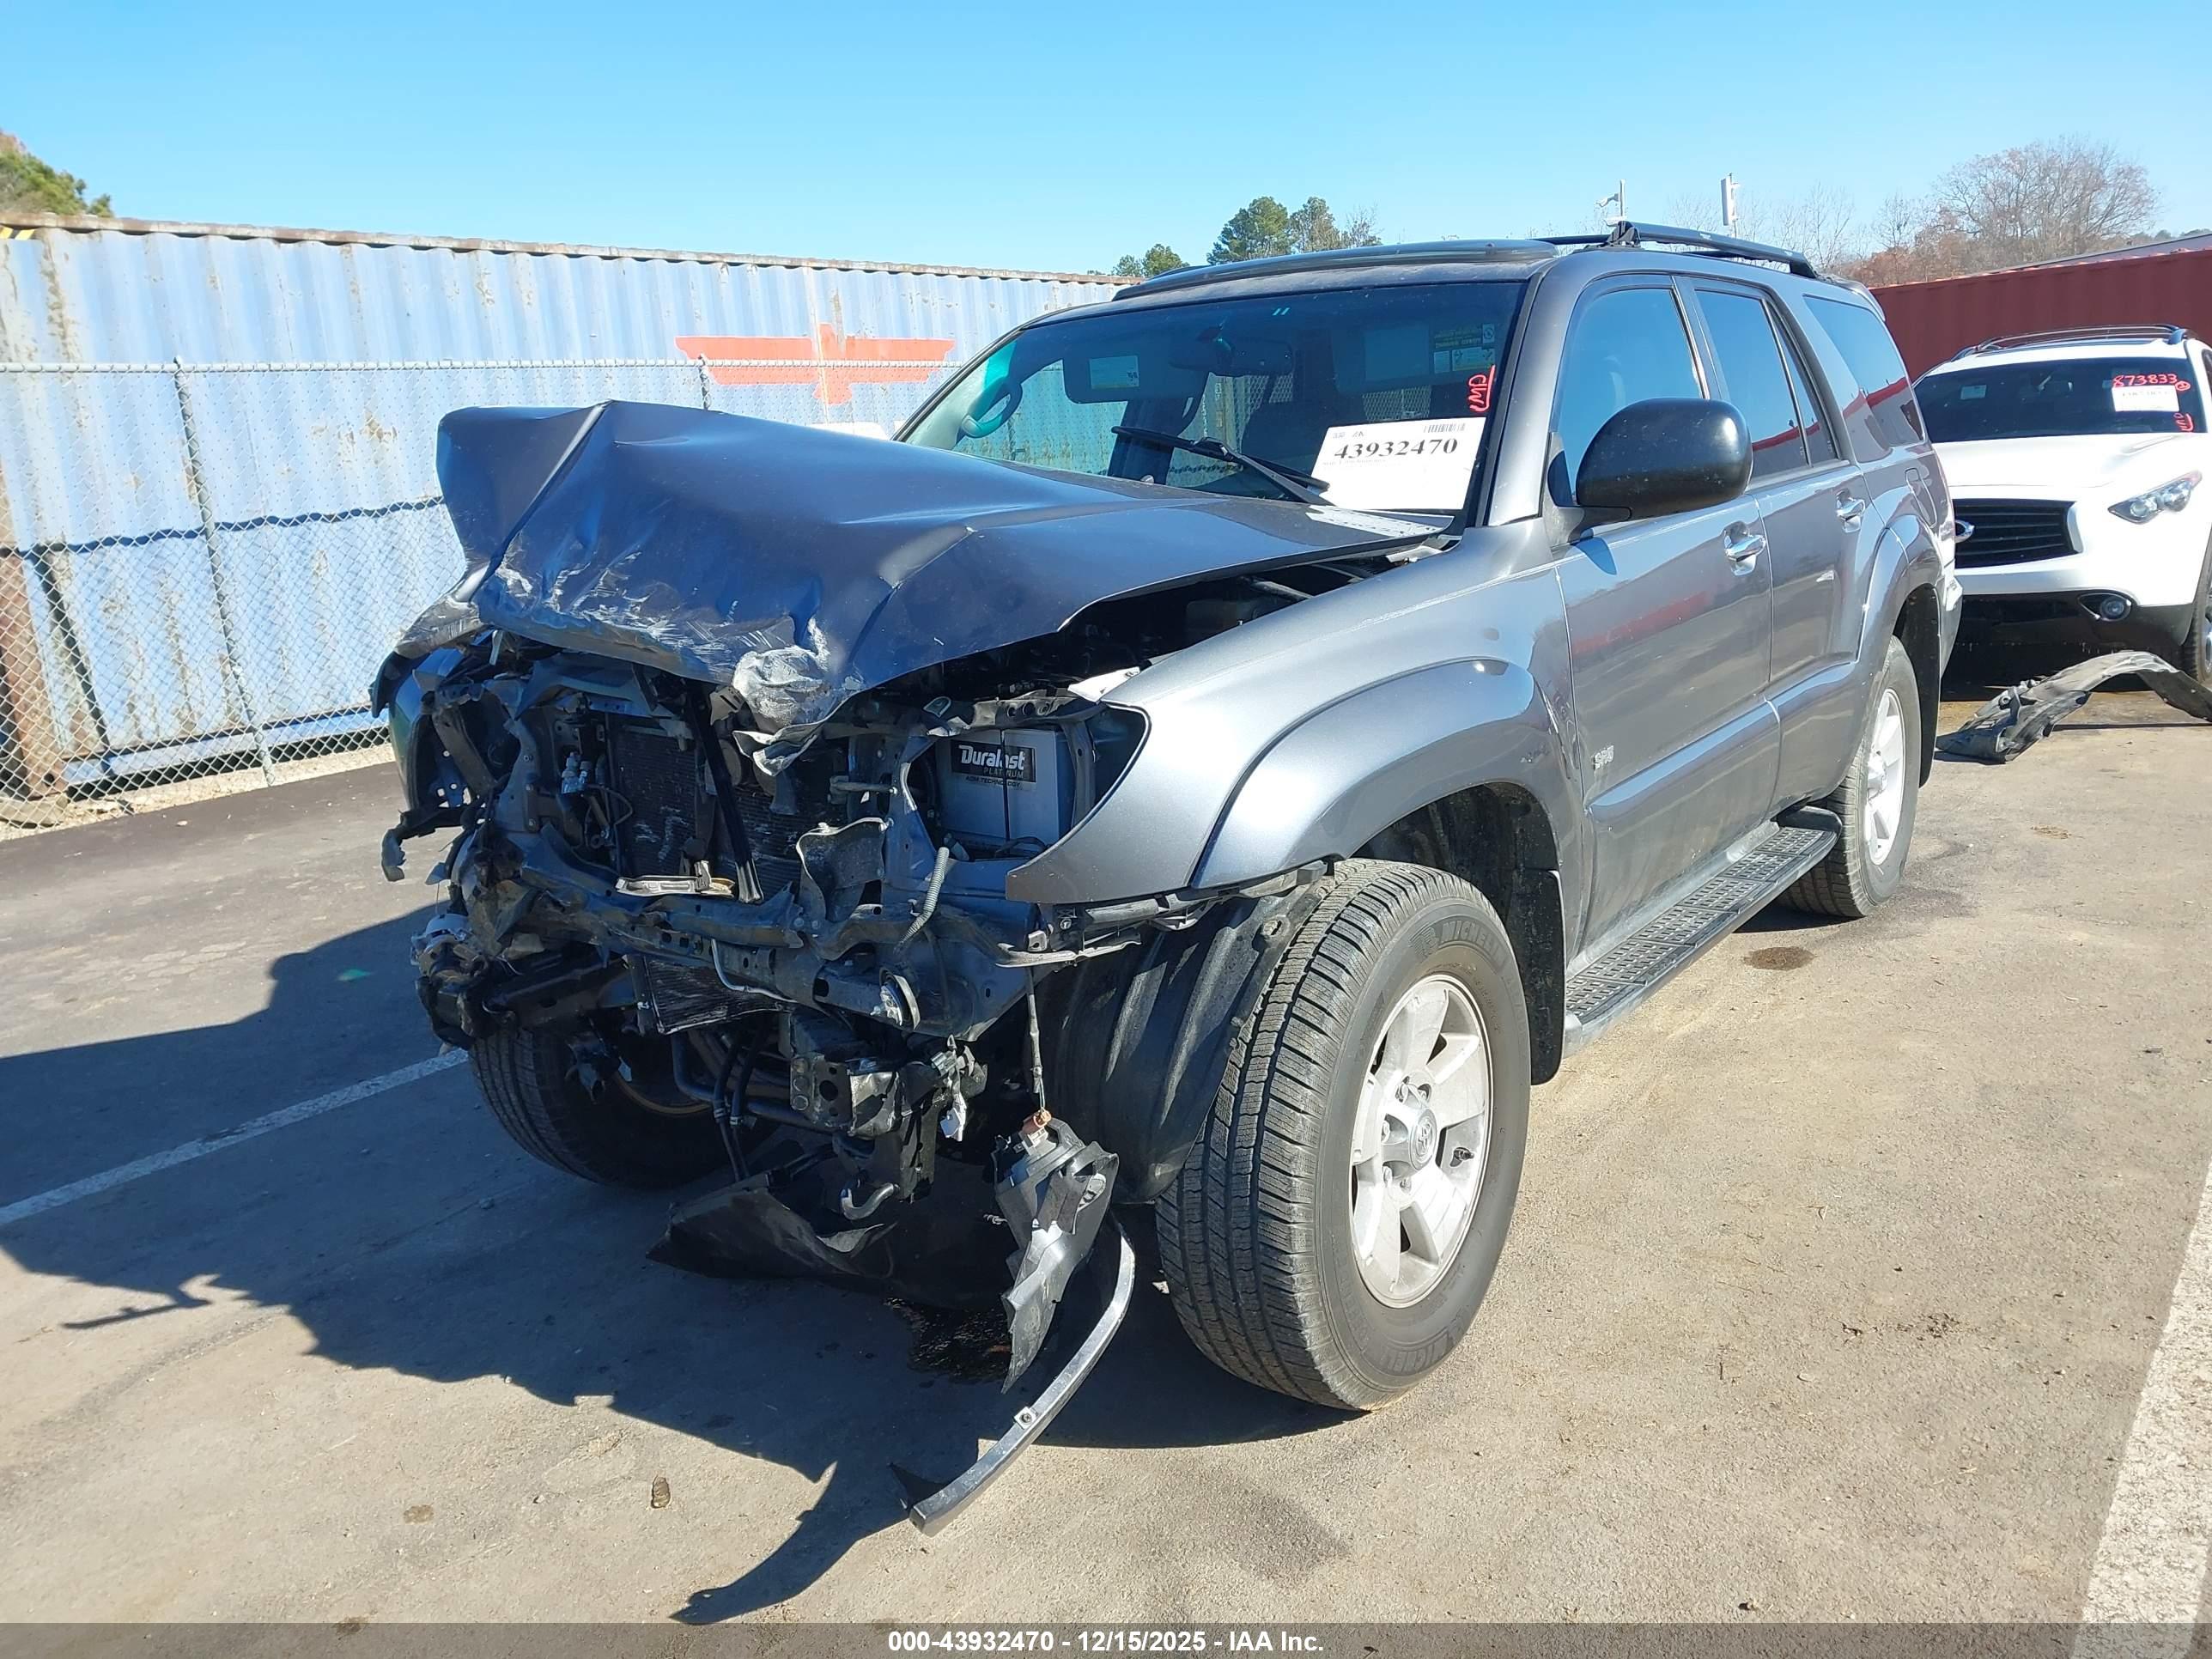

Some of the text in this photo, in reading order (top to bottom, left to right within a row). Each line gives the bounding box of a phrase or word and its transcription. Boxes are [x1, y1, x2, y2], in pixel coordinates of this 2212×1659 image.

[2112, 373, 2178, 388] 873833
[1334, 438, 1459, 459] 43932470
[958, 744, 1025, 771] Duralast
[982, 767, 1024, 780] PLATNUM
[981, 776, 1021, 788] TECHNOOGY
